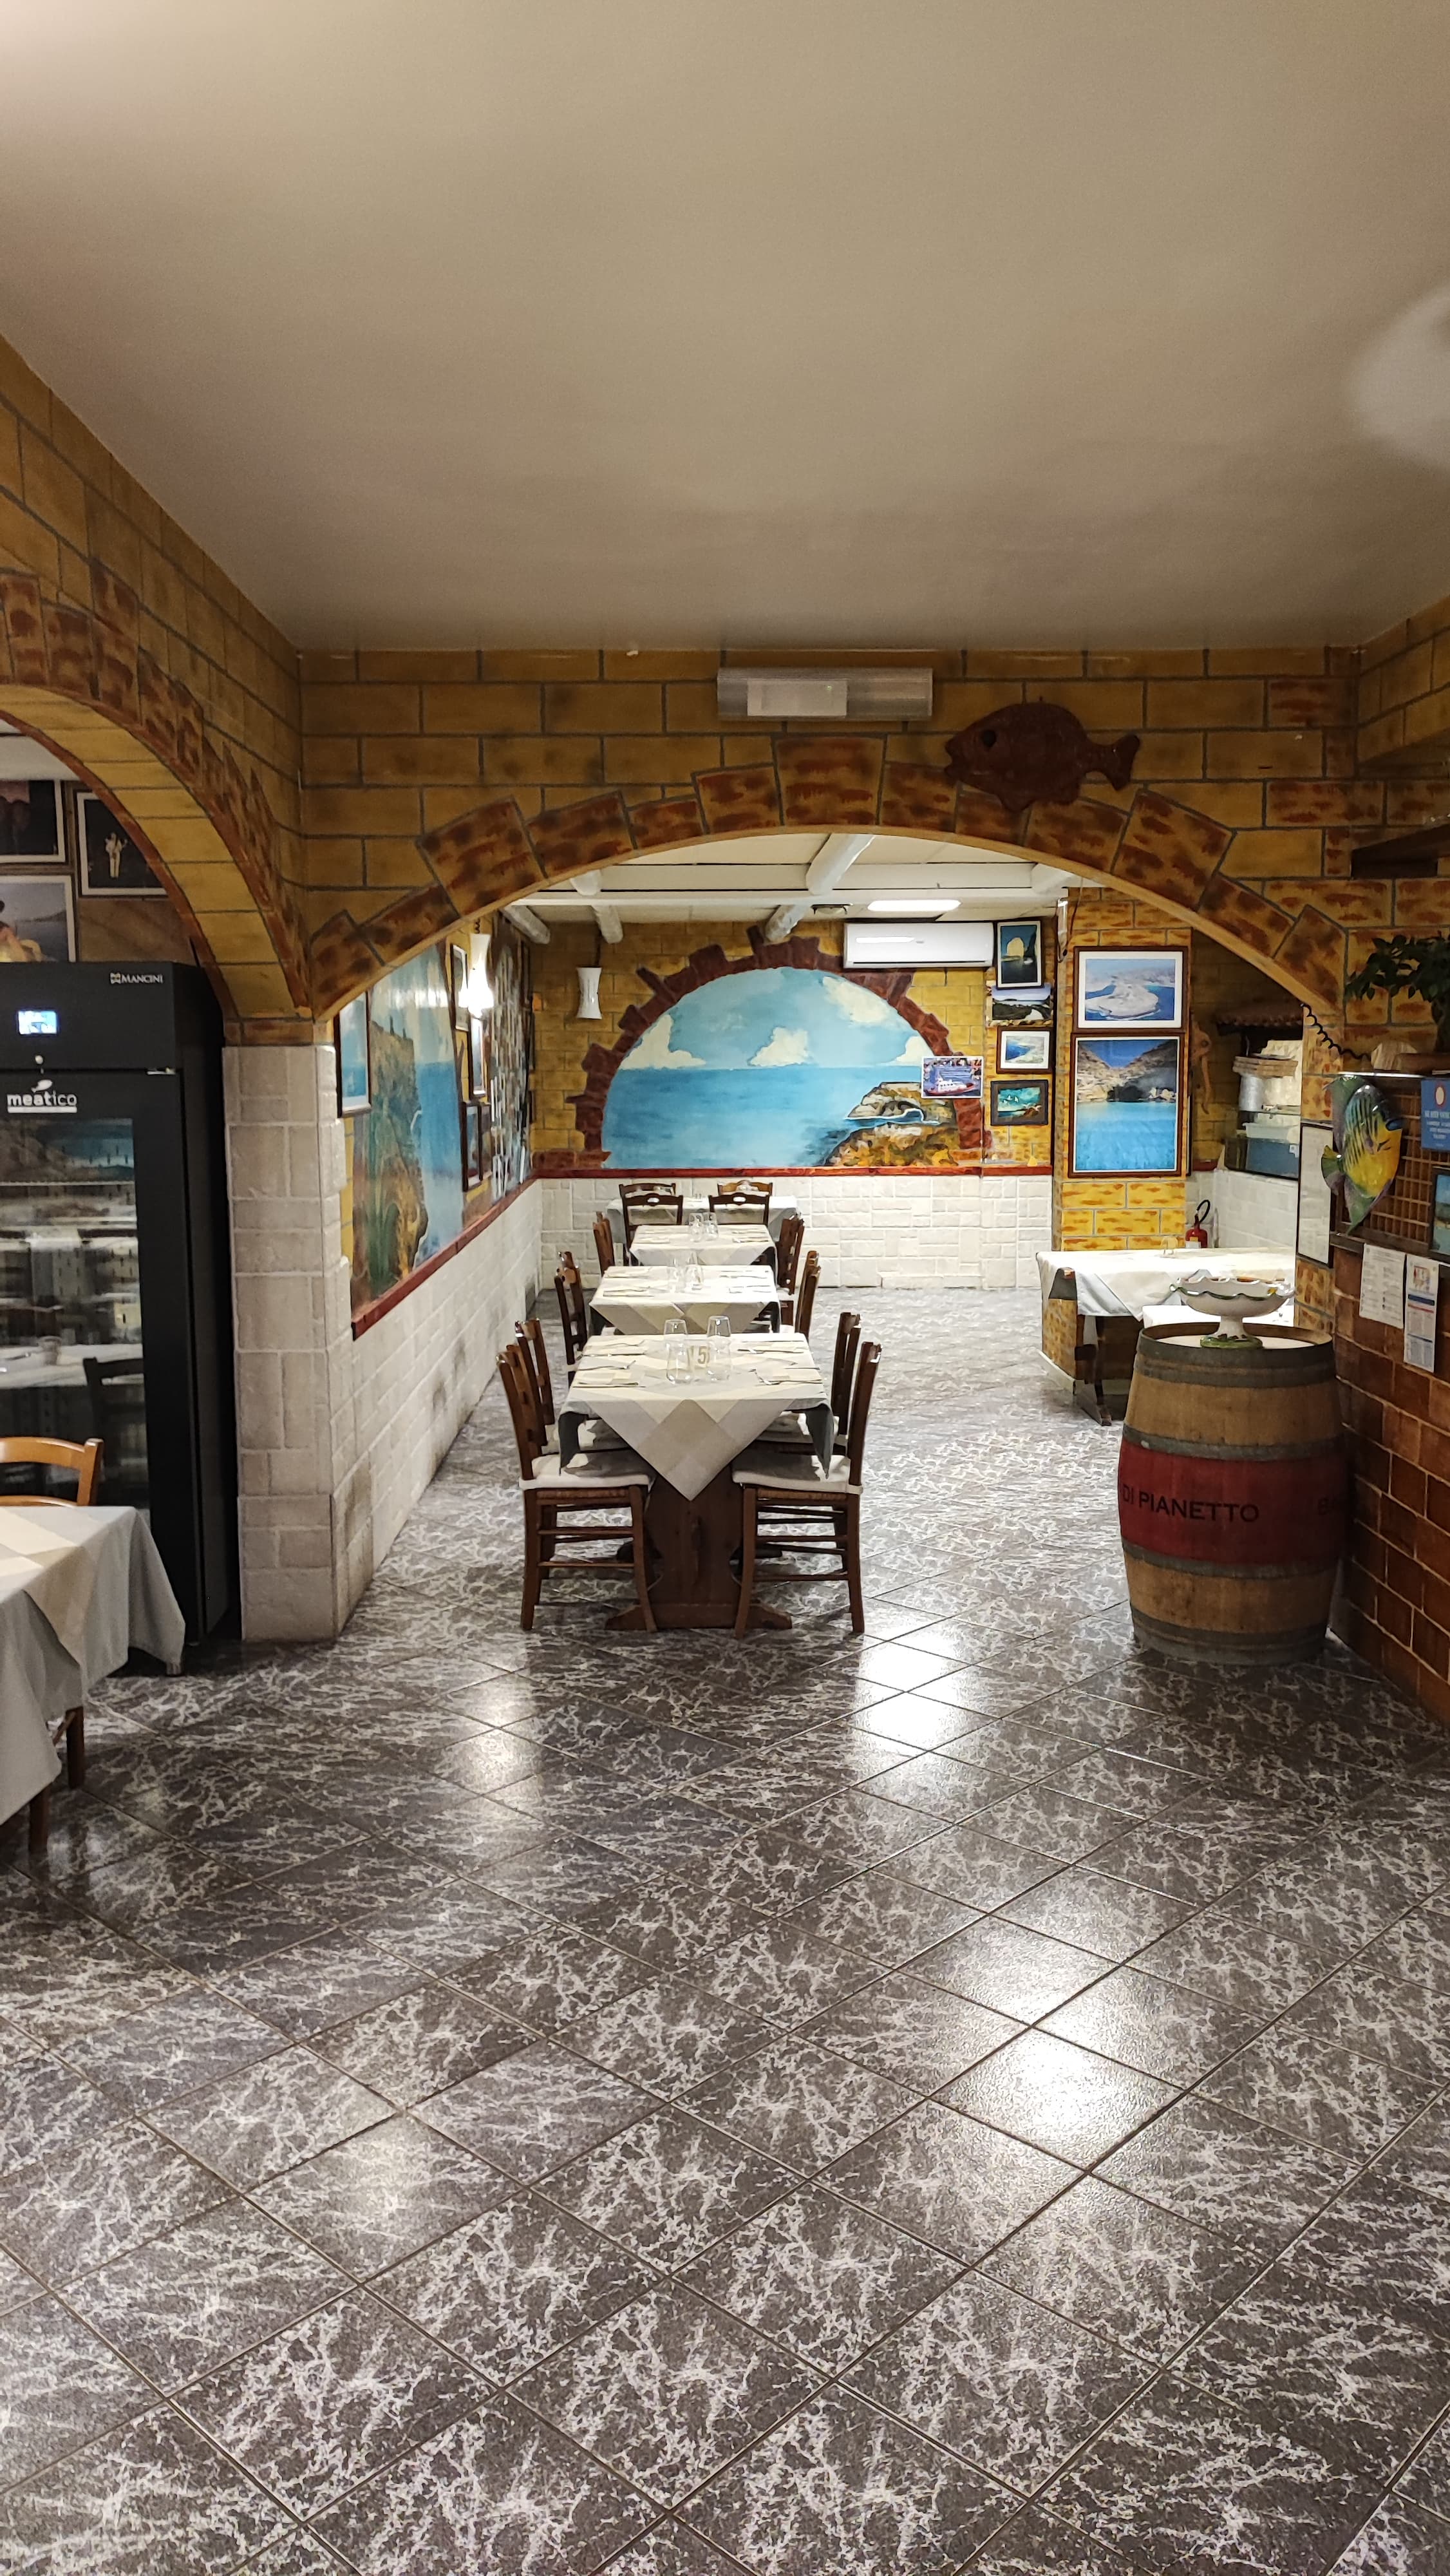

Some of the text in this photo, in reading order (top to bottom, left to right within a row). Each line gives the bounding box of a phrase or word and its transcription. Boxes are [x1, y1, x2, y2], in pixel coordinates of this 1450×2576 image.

[121, 974, 163, 983] MANCINI
[7, 1090, 77, 1106] meatico
[1122, 1484, 1259, 1522] DI PIANETTO
